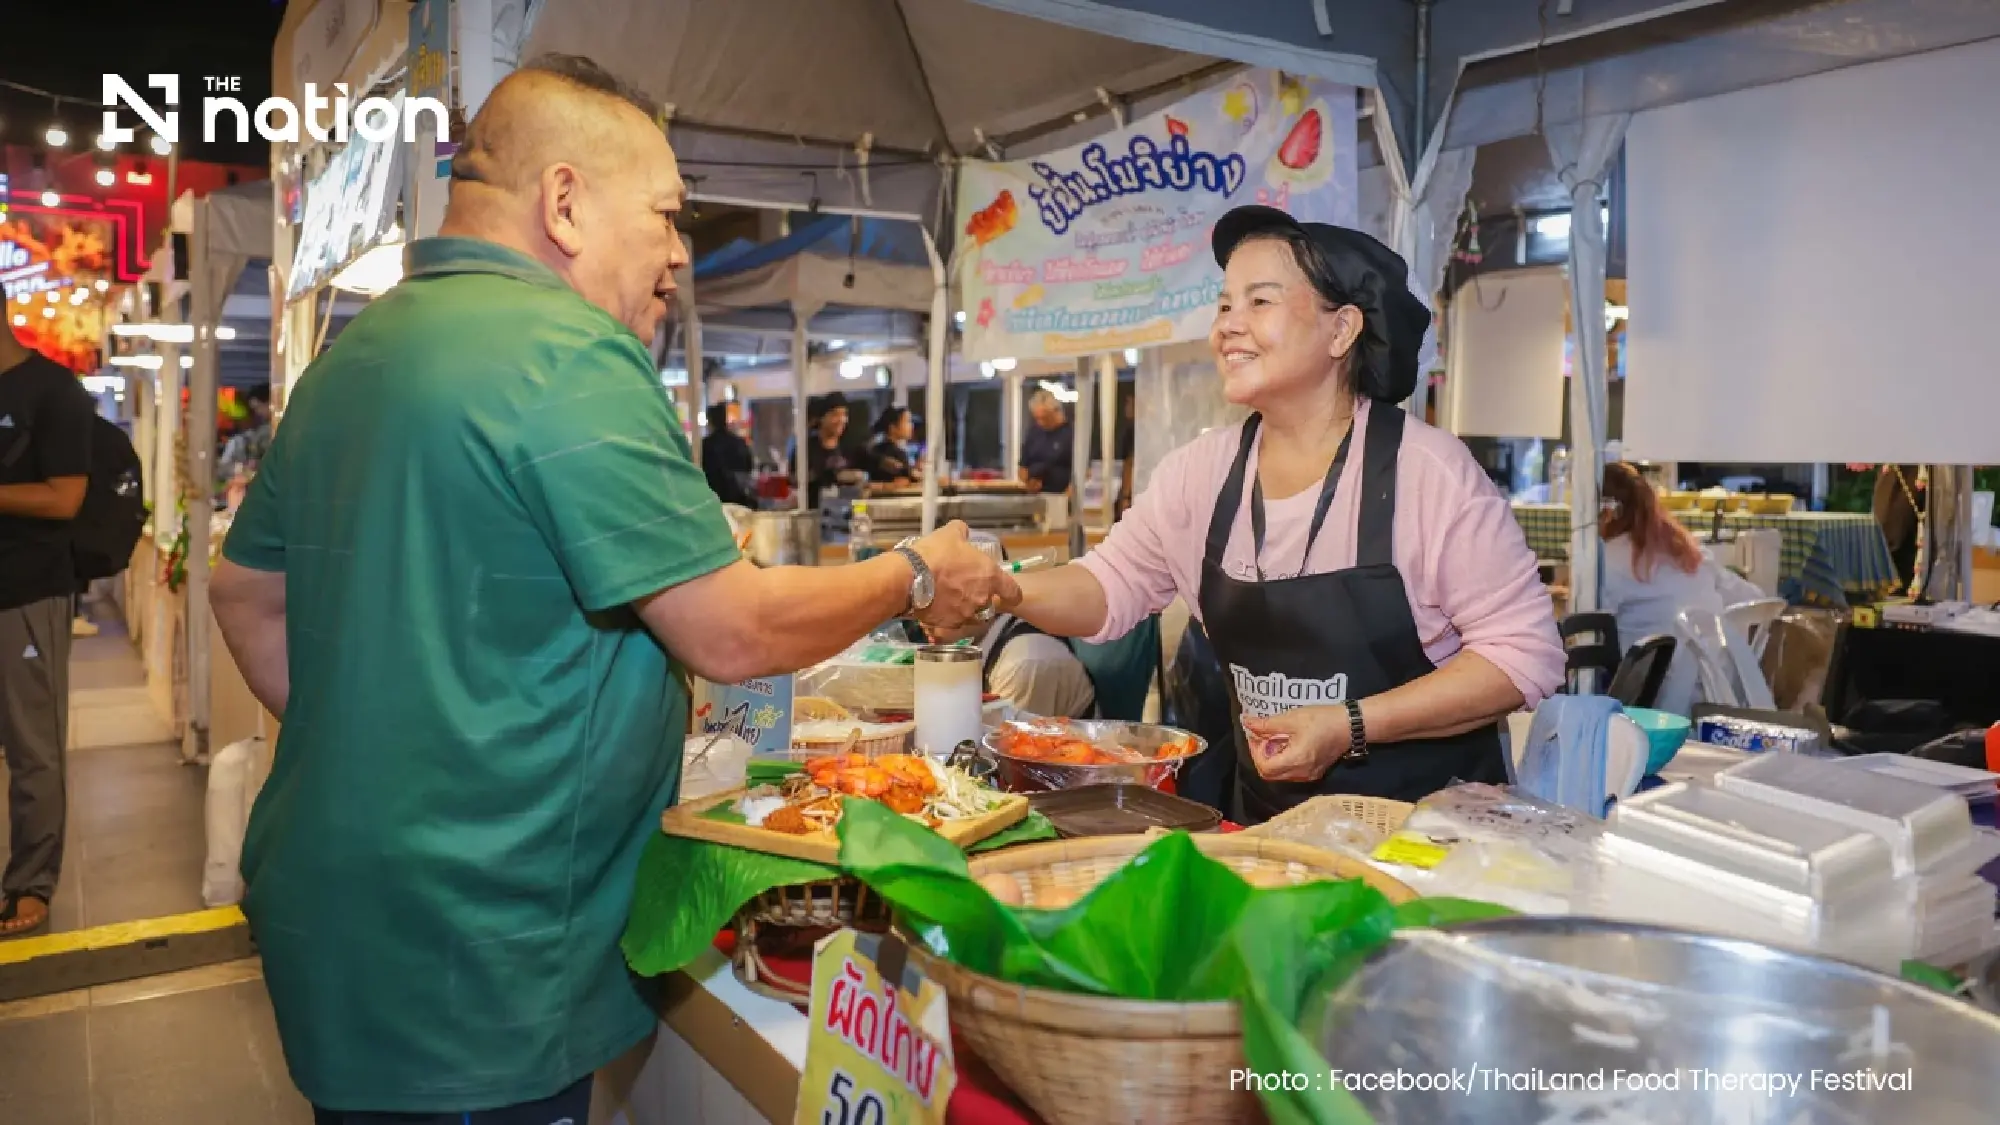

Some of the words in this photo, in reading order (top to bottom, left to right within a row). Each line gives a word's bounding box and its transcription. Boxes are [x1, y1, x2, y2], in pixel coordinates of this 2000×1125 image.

[1233, 668, 1342, 701] Thailand
[827, 961, 938, 1100] ผัดไทย
